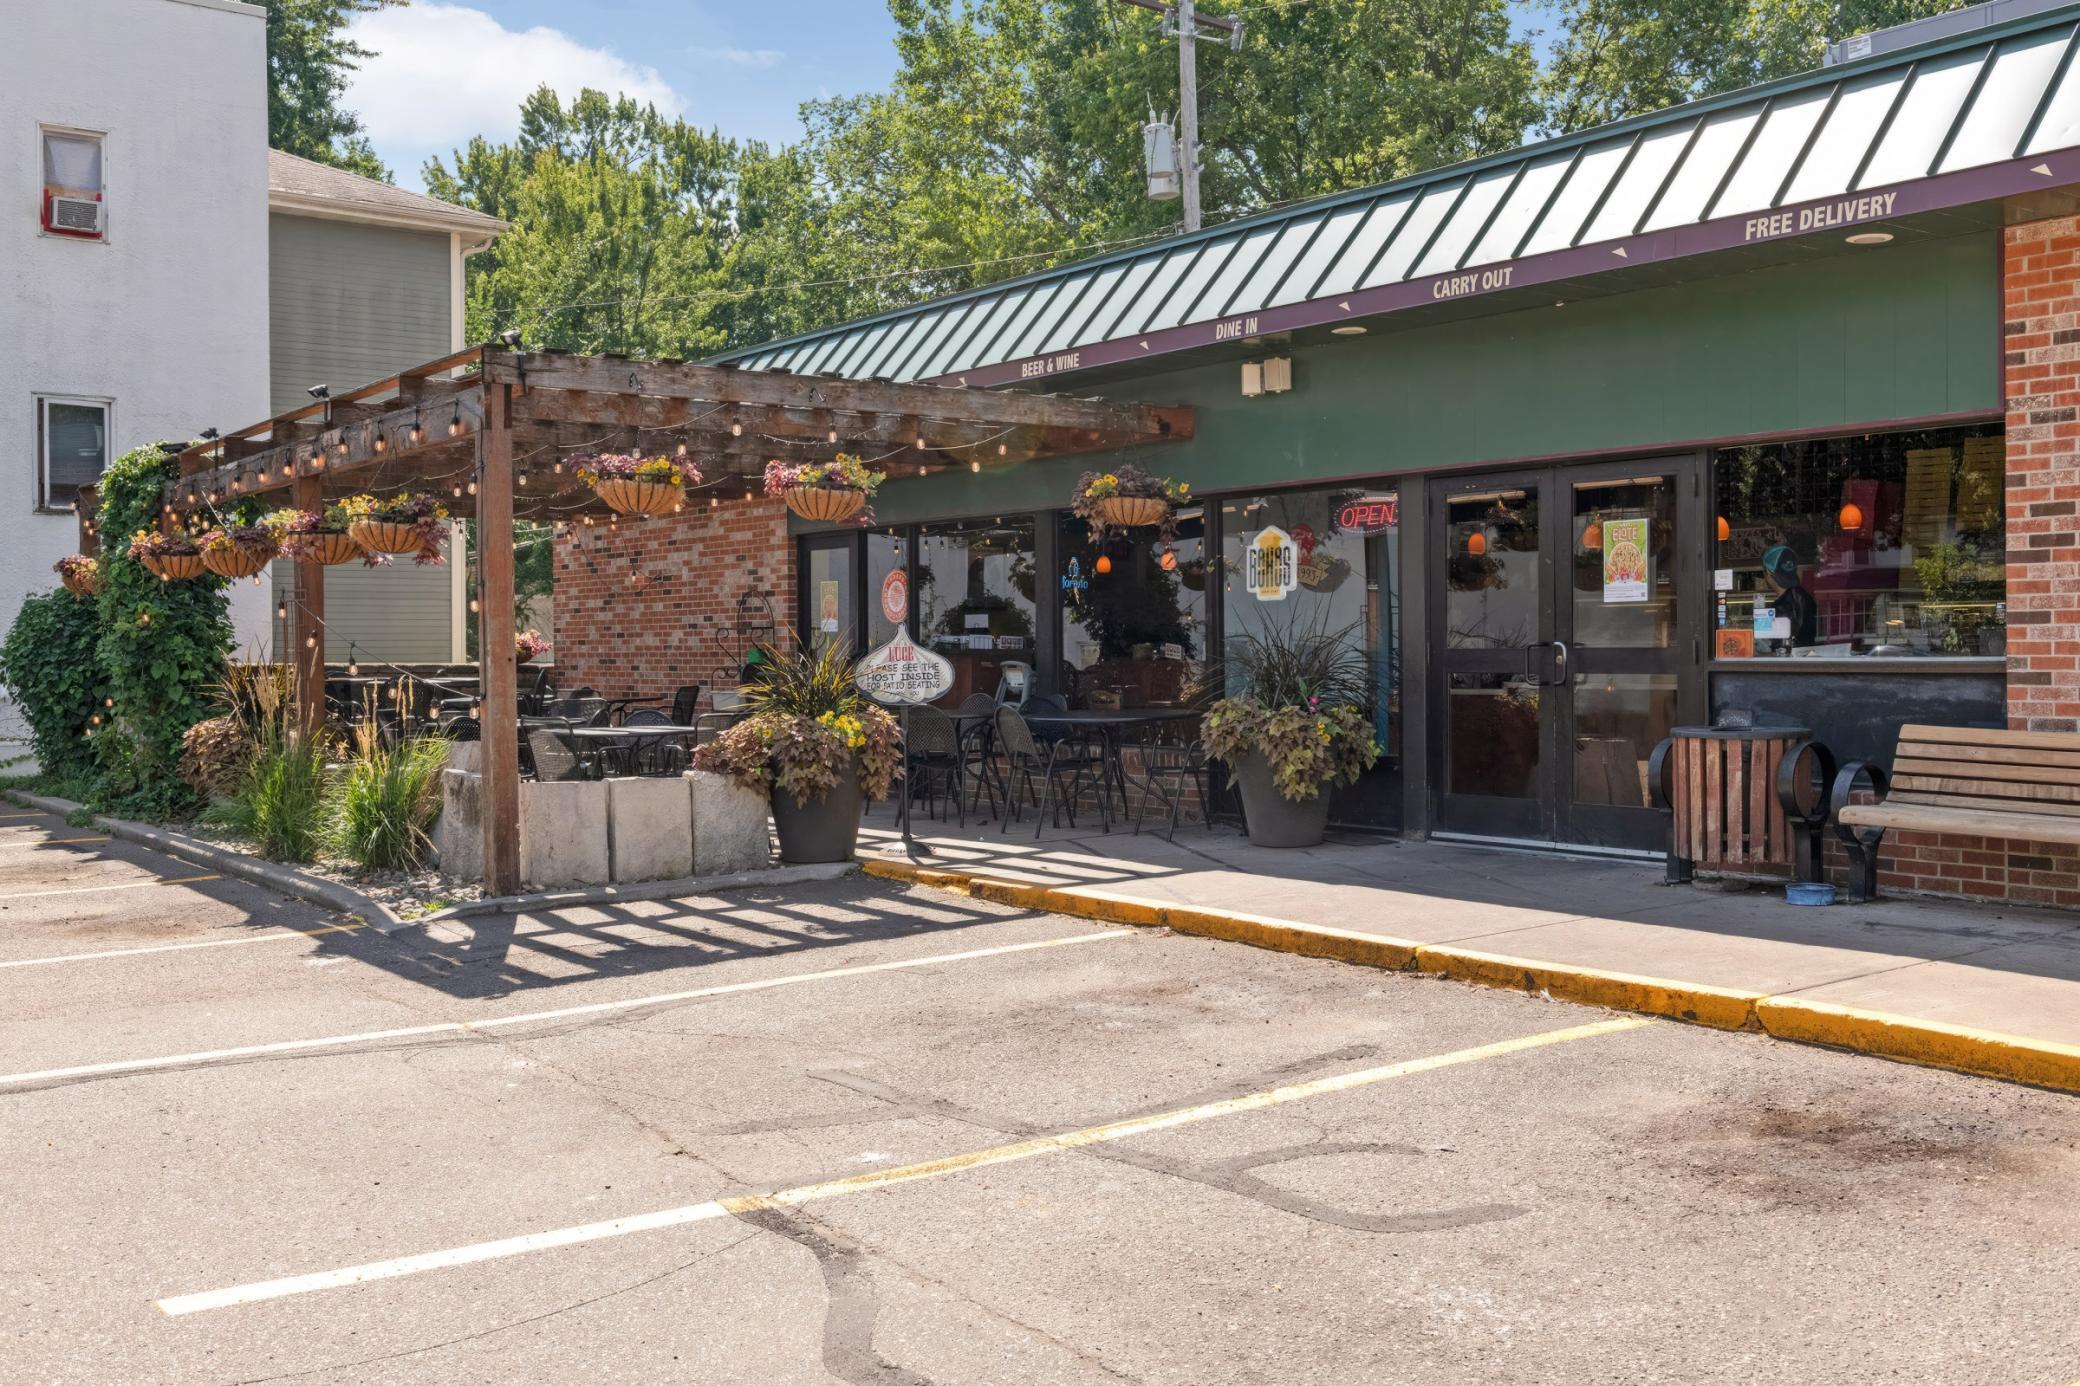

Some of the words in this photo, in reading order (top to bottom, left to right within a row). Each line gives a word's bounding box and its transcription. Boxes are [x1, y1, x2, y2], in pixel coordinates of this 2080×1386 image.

[1745, 212, 1793, 241] FREE
[1799, 191, 1897, 231] DELIVERY
[1433, 273, 1479, 299] CARRY
[1482, 267, 1513, 290] OUT
[1216, 320, 1242, 340] DINE
[1245, 317, 1258, 335] IN
[1022, 360, 1045, 378] BEER
[1046, 358, 1054, 373] &
[1056, 352, 1080, 371] WINE
[1340, 503, 1396, 528] OPEN
[866, 673, 896, 682] HOST
[900, 672, 940, 681] INSIDE
[902, 663, 919, 672] SEE
[921, 662, 940, 671] THE
[866, 682, 881, 690] FOR
[883, 681, 905, 690] PATIO
[908, 680, 940, 689] SEATING
